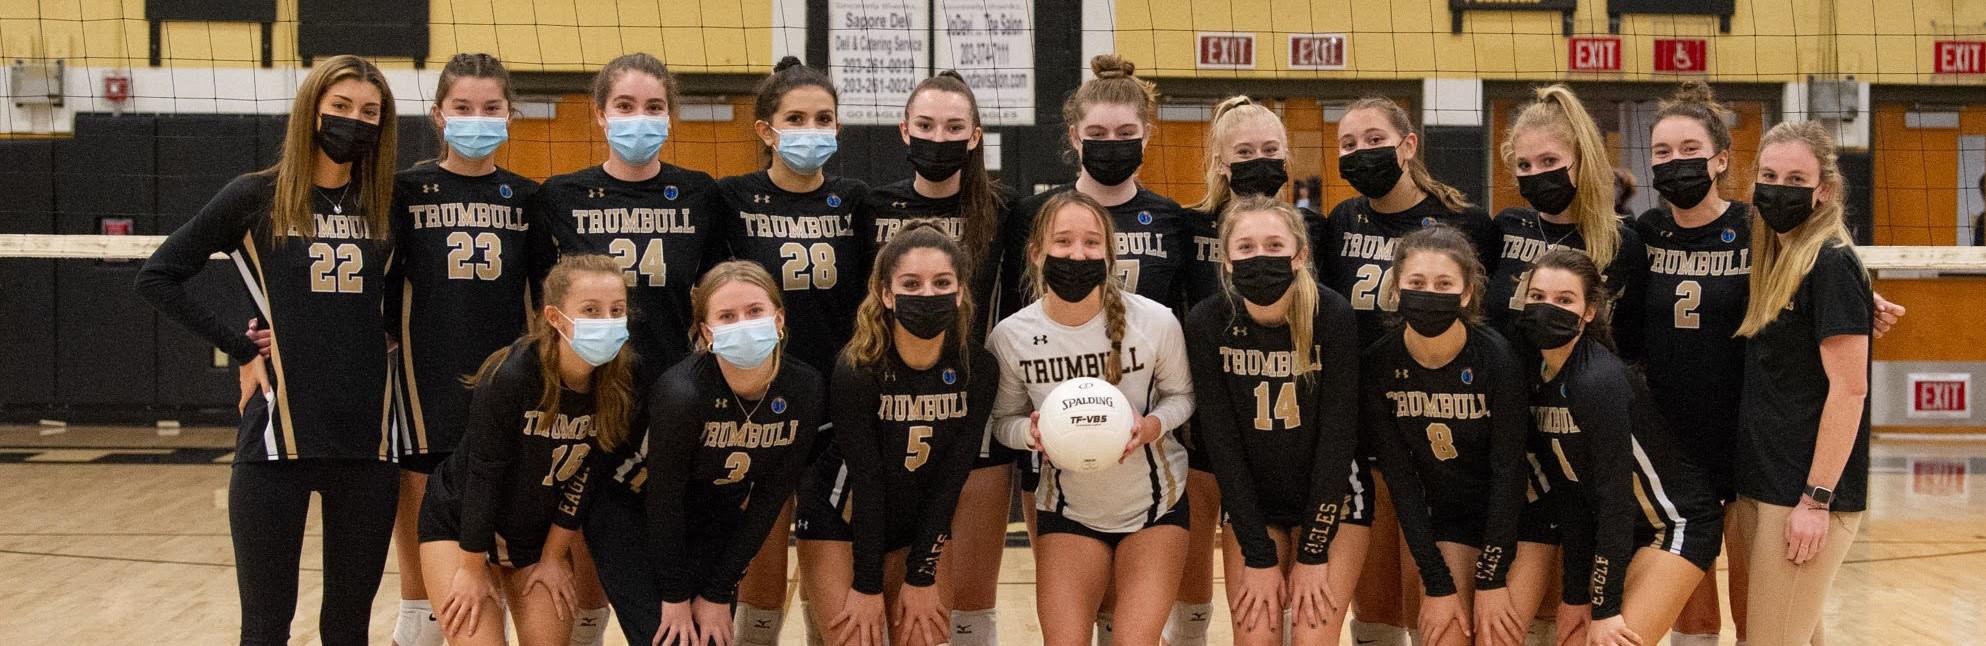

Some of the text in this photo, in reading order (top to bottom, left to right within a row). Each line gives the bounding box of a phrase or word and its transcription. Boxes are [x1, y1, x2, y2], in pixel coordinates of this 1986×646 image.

[1208, 38, 1247, 63] EXIT
[1300, 38, 1338, 64] EXIT
[1576, 41, 1616, 69] EXIT
[1941, 44, 1981, 71] EXIT
[408, 202, 529, 232] TRUMBULL
[572, 207, 696, 235] TRUMBULL
[740, 210, 855, 239] TRUMBULL
[446, 231, 502, 281] 23
[609, 238, 667, 287] 24
[1114, 232, 1168, 259] BULL
[308, 242, 363, 294] 22
[779, 242, 838, 291] 28
[1112, 259, 1141, 295] 7
[1674, 280, 1702, 330] 2
[1062, 396, 1114, 411] SPALDING
[1253, 381, 1301, 431] 14
[1921, 382, 1961, 410] EXIT
[904, 425, 934, 473] 5
[1425, 422, 1459, 462] 8
[541, 442, 592, 487] 16
[713, 451, 751, 486] 3
[1551, 438, 1580, 483] 1
